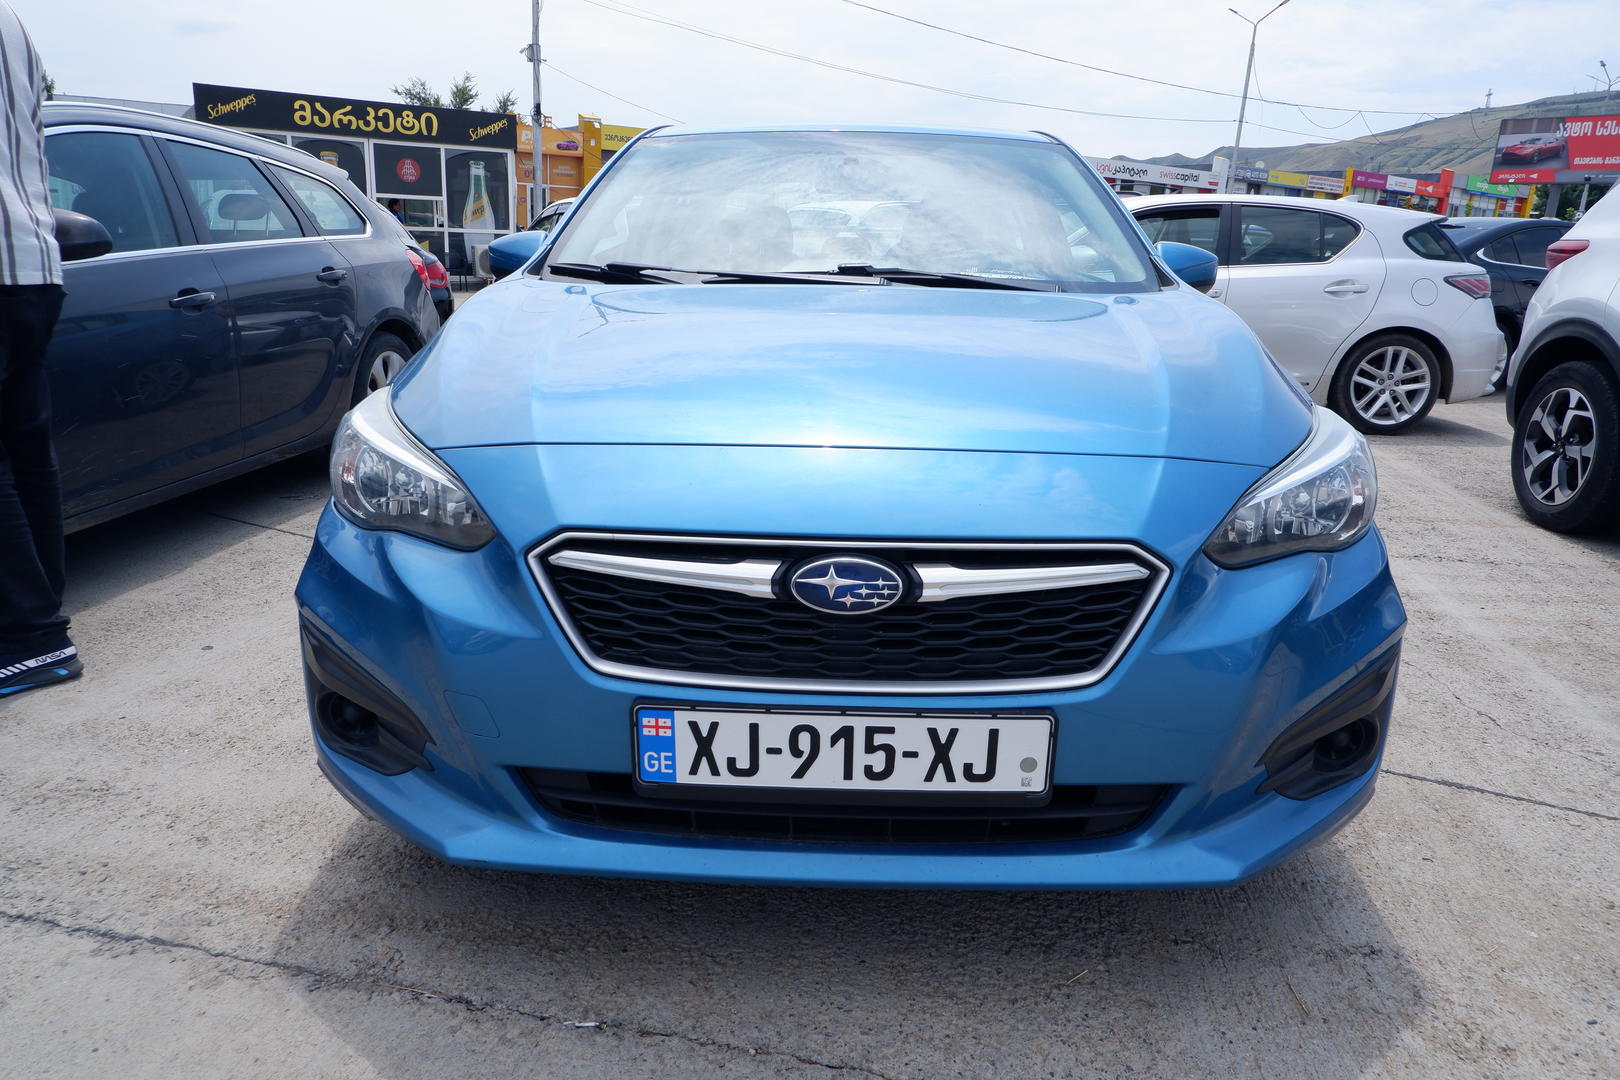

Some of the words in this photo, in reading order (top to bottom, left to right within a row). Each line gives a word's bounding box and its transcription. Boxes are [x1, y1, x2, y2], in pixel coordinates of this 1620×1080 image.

[207, 94, 256, 119] Schweppes
[293, 100, 438, 136] მარკეტი
[469, 118, 508, 141] Schweppes
[1159, 170, 1200, 182] swisscapital
[35, 651, 67, 665] NASA
[643, 751, 673, 773] GE
[687, 719, 1001, 784] XJ-915-XJ
